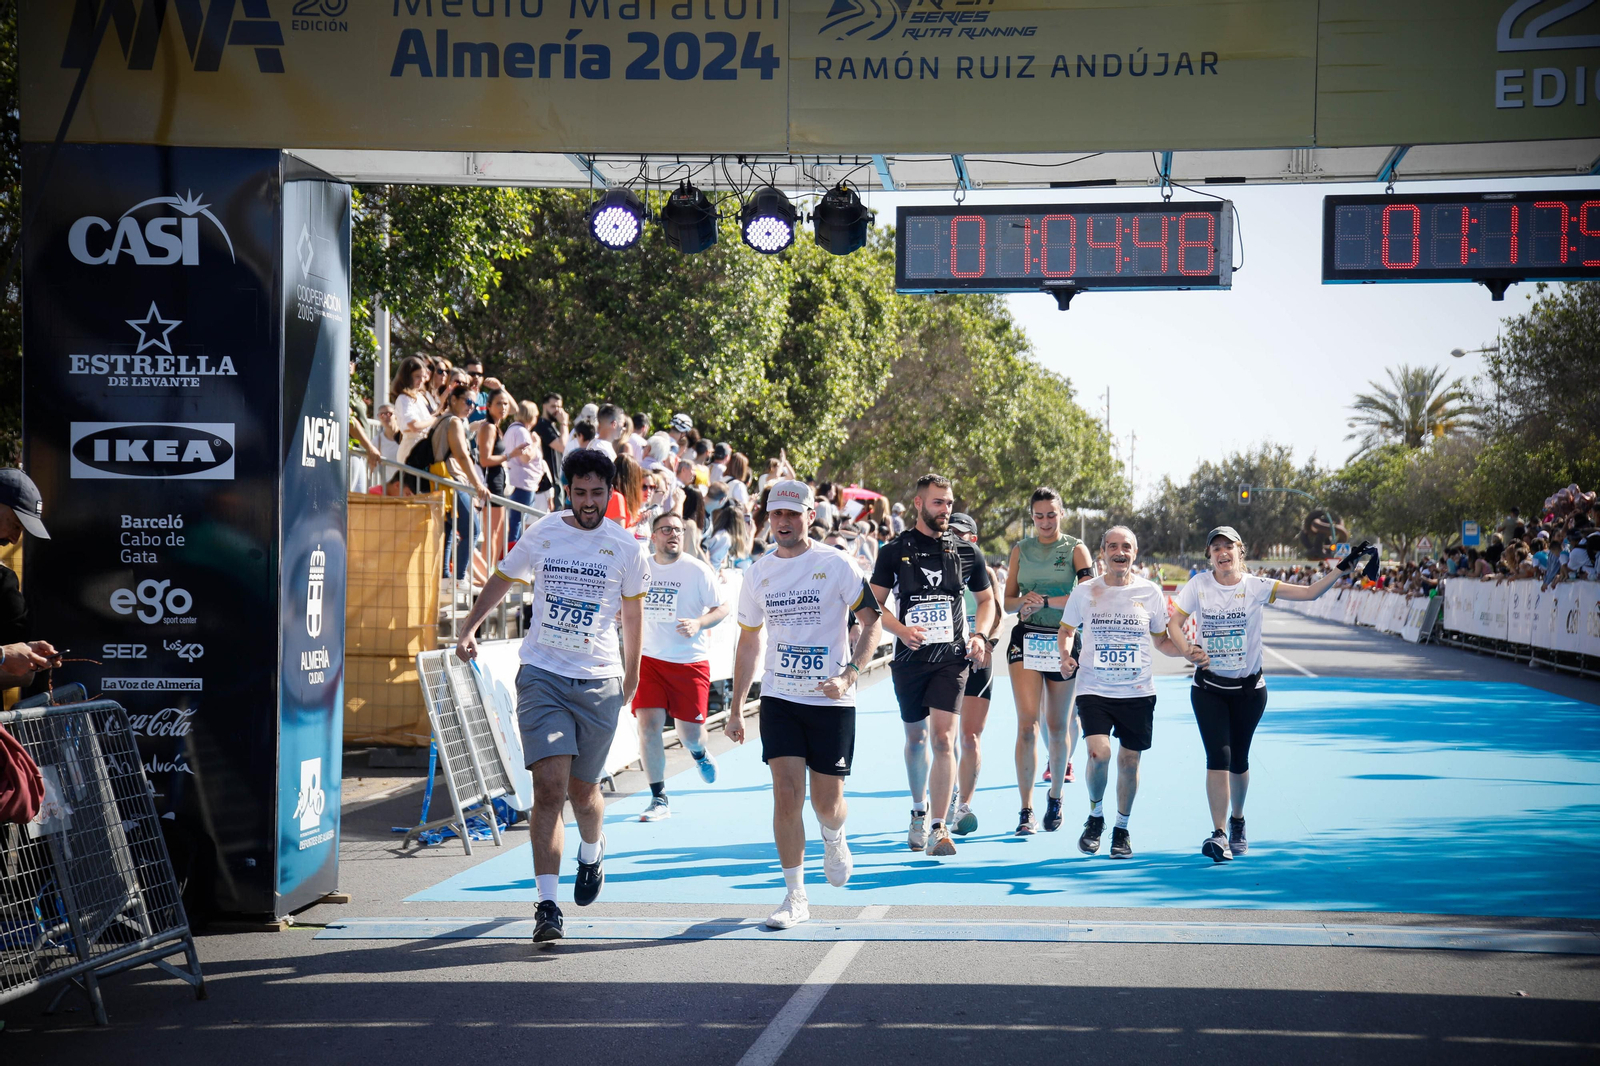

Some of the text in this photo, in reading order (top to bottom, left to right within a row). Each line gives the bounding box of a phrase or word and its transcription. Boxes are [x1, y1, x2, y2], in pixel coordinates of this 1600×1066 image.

[292, 18, 348, 32] EDICIÓN
[908, 10, 991, 26] SERIES
[902, 26, 1038, 40] RUTA RUNNING
[390, 28, 780, 80] Almería 2024
[815, 46, 1219, 80] RAMÓN RUIZ ANDÚJAR
[1496, 66, 1600, 109] EDI
[68, 215, 200, 266] CASI
[296, 284, 342, 313] COOPERACIÓN
[297, 302, 314, 322] 2005
[68, 354, 238, 376] ESTRELLA
[108, 376, 200, 388] DE LEVANTE
[94, 438, 217, 462] IKEA
[777, 490, 800, 499] LALIGA
[120, 514, 184, 529] Barceló
[120, 532, 185, 546] Cabo de
[120, 549, 158, 564] Gata
[543, 558, 608, 570] Medio Maratón
[542, 564, 607, 579] Almería 2024
[580, 577, 606, 585] ANDÚJAR
[110, 578, 193, 625] ego
[645, 593, 674, 604] 5242
[765, 595, 819, 607] Almería 2024
[163, 617, 178, 626] sport
[549, 604, 594, 627] 5795
[911, 610, 947, 624] 5388
[1207, 636, 1243, 650] 5050
[102, 644, 148, 658] SER
[177, 643, 204, 663] 40
[300, 645, 330, 671] ALMERÍA
[1100, 651, 1135, 663] 5051
[780, 653, 824, 670] 5796
[103, 680, 201, 689] La Voz de Almería
[308, 671, 324, 685] CIUDAD
[106, 753, 195, 775] Analucía
